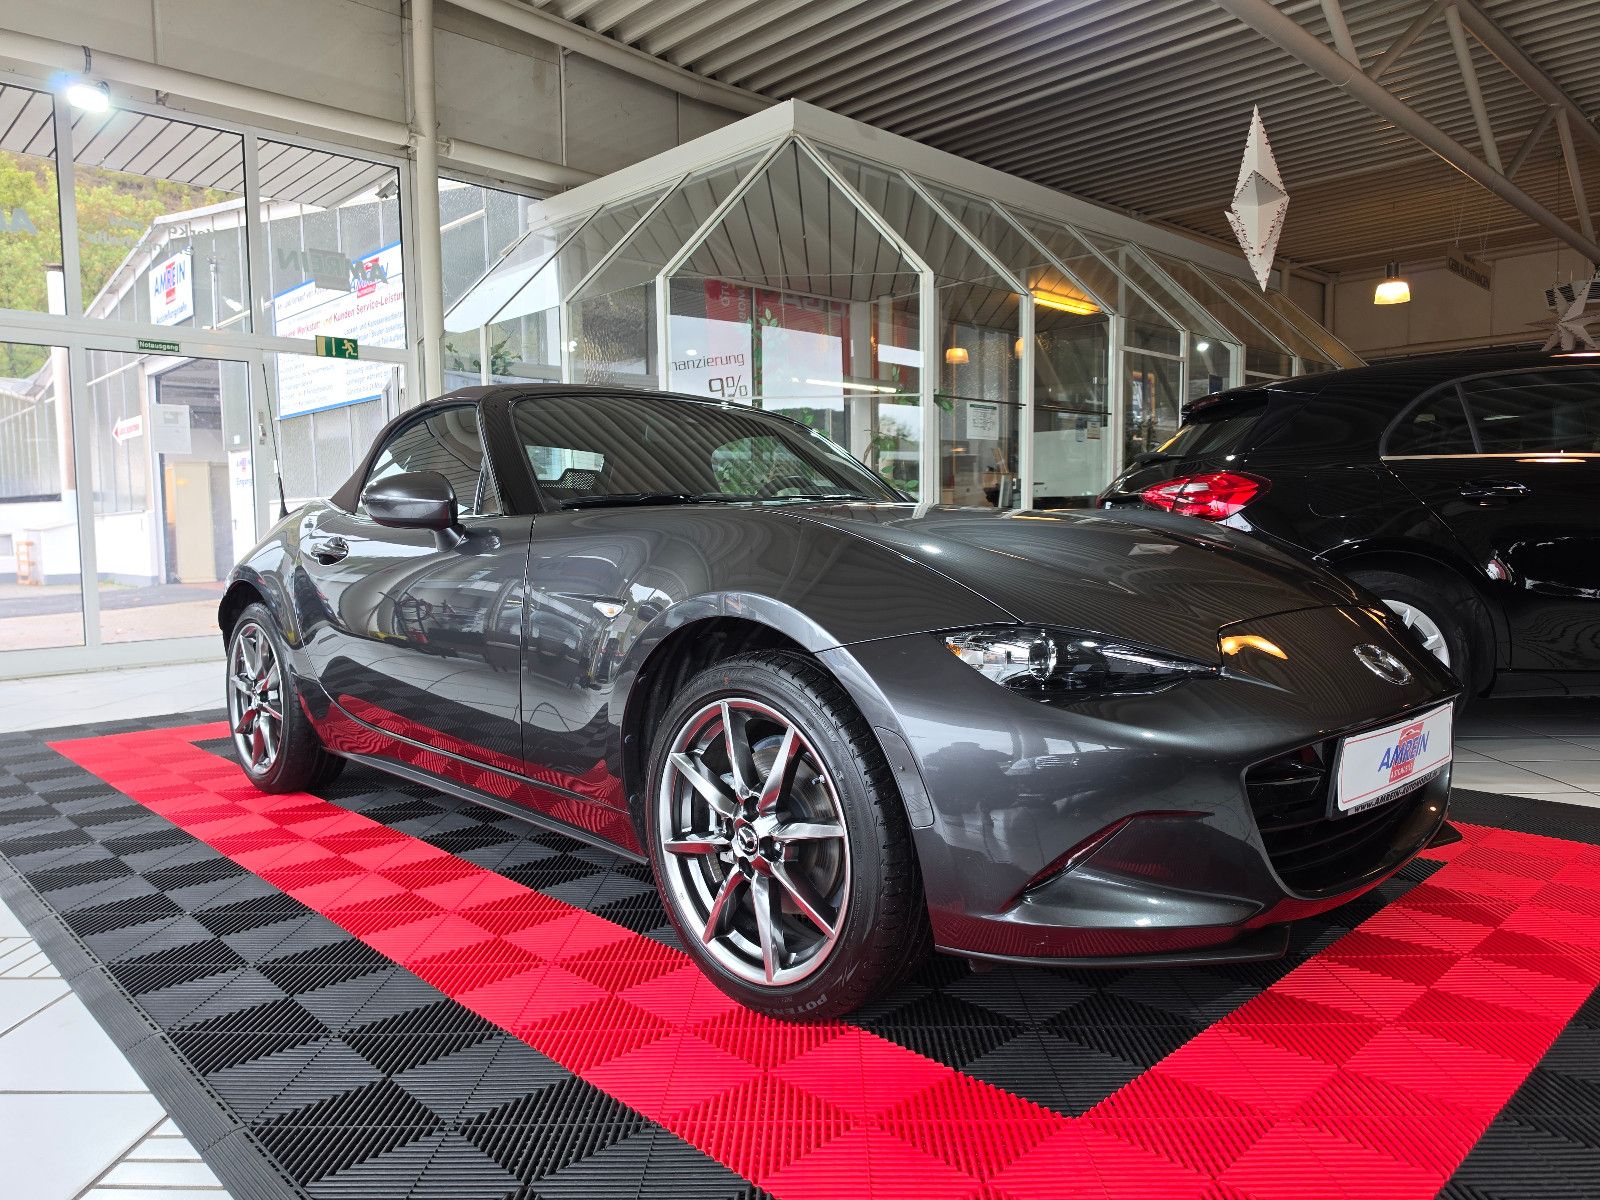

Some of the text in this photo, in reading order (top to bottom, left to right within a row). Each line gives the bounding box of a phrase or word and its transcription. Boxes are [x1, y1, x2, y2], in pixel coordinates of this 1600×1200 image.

[153, 260, 185, 296] AMREIN
[333, 309, 355, 322] Kunden
[139, 341, 180, 352] Notausgang
[1378, 731, 1430, 772] AMREIN
